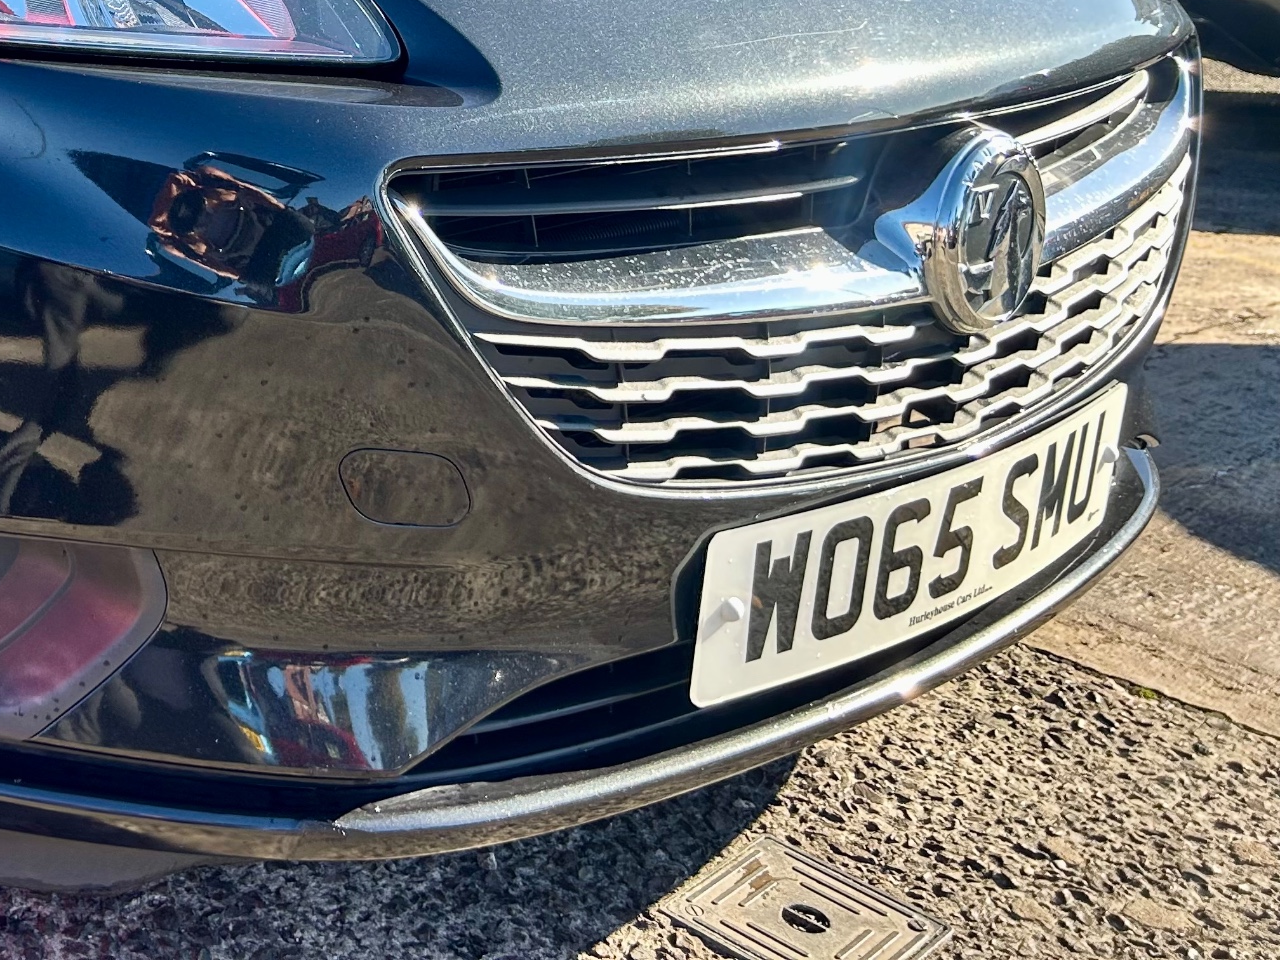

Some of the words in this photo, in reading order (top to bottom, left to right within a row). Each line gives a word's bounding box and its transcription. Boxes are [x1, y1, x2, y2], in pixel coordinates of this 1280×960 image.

[744, 476, 984, 664] WO65
[992, 410, 1107, 571] SMU
[909, 600, 955, 627] Hurleyhouse
[957, 592, 972, 606] Cars
